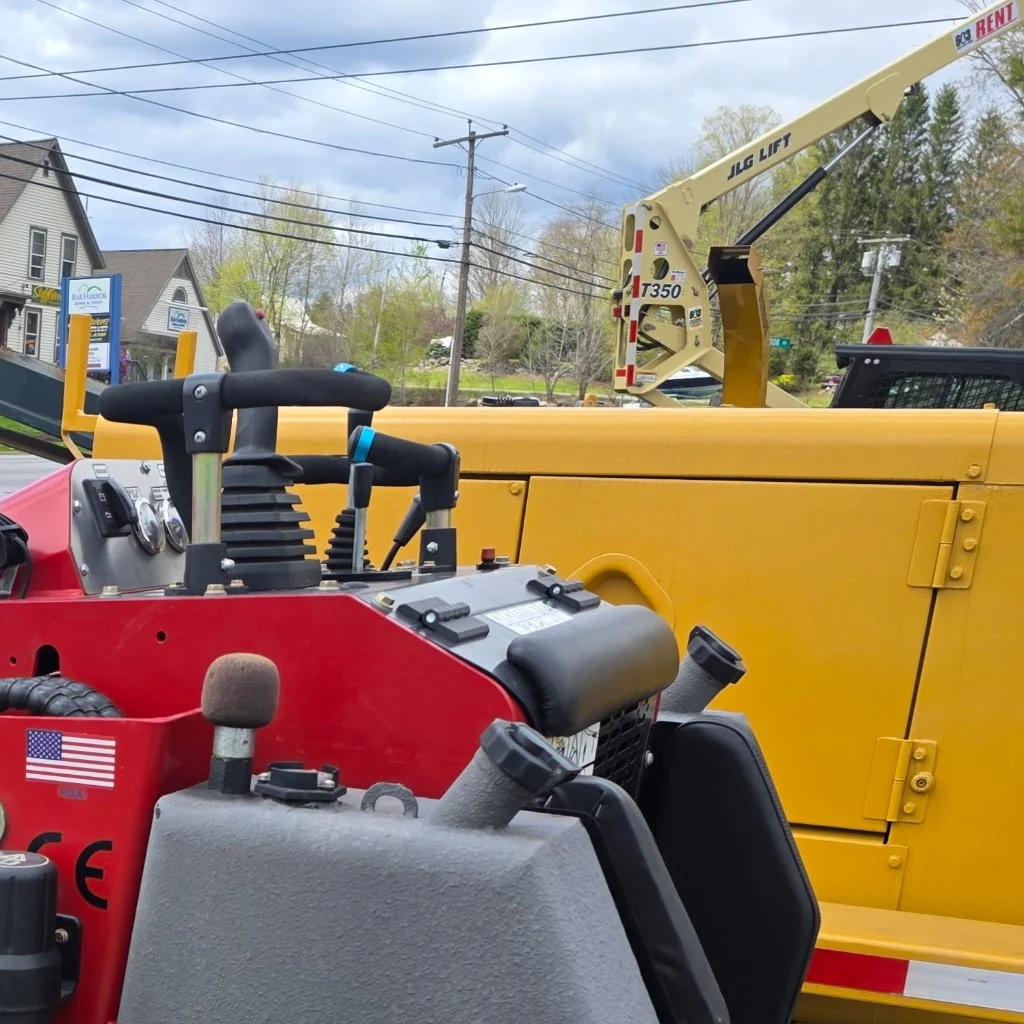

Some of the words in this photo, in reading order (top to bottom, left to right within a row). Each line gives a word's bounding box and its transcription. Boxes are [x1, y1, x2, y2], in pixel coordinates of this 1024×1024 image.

[976, 3, 1014, 38] RENT
[955, 29, 972, 47] 603
[727, 154, 754, 180] JLG
[759, 132, 791, 162] LIFT
[641, 283, 682, 299] T350
